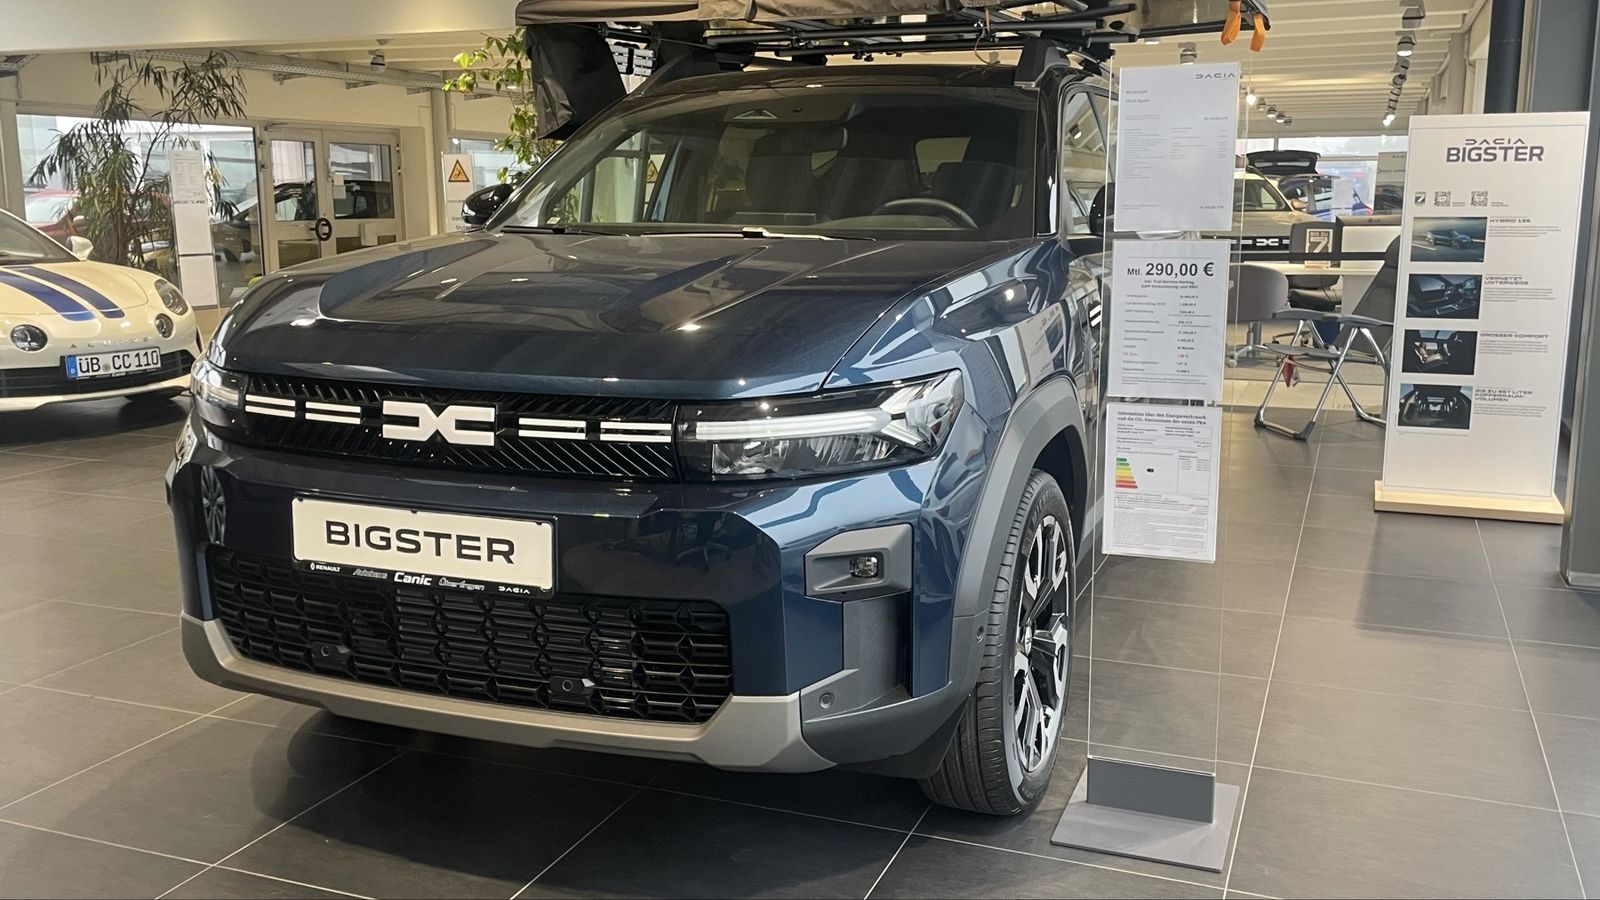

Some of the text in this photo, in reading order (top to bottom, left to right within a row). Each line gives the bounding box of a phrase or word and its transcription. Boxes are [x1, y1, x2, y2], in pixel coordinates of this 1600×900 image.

[1446, 146, 1544, 163] BIGSTER
[1127, 262, 1214, 278] Mtl. 290,00 €
[79, 350, 159, 373] ÜB CC 110
[325, 520, 515, 565] BIGSTER
[315, 564, 341, 573] RENAULT
[393, 572, 432, 586] Canic
